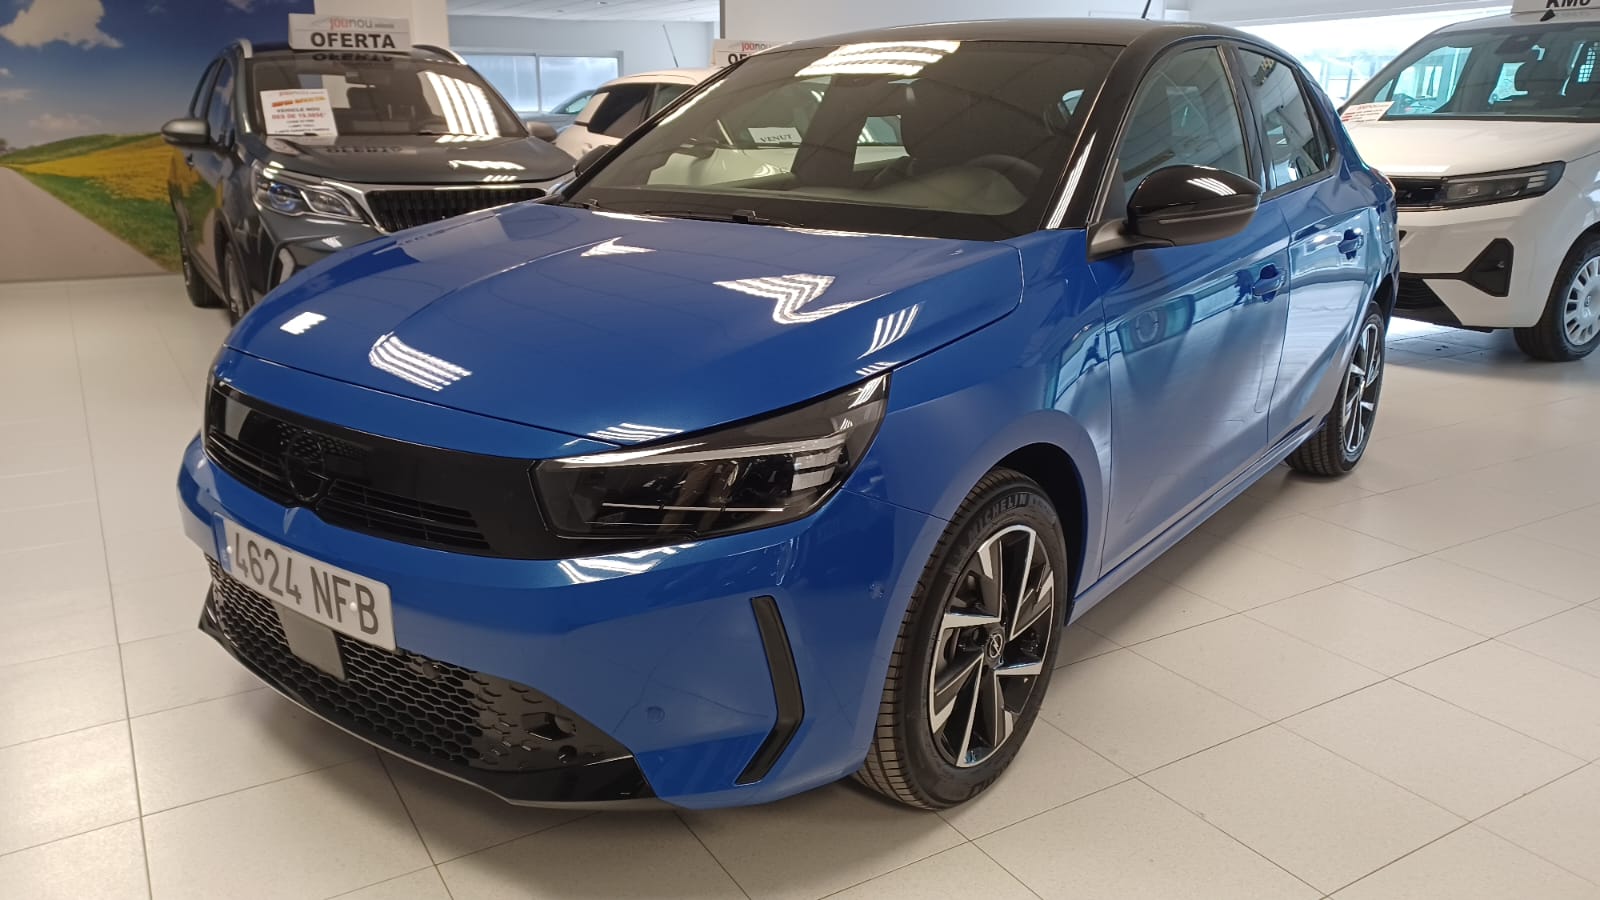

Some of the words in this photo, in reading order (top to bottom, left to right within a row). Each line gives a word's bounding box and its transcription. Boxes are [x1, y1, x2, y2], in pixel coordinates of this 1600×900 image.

[310, 32, 396, 49] OFERTA
[968, 493, 1027, 545] MICHELIN
[235, 533, 302, 605] 4624
[310, 566, 379, 635] NFB
